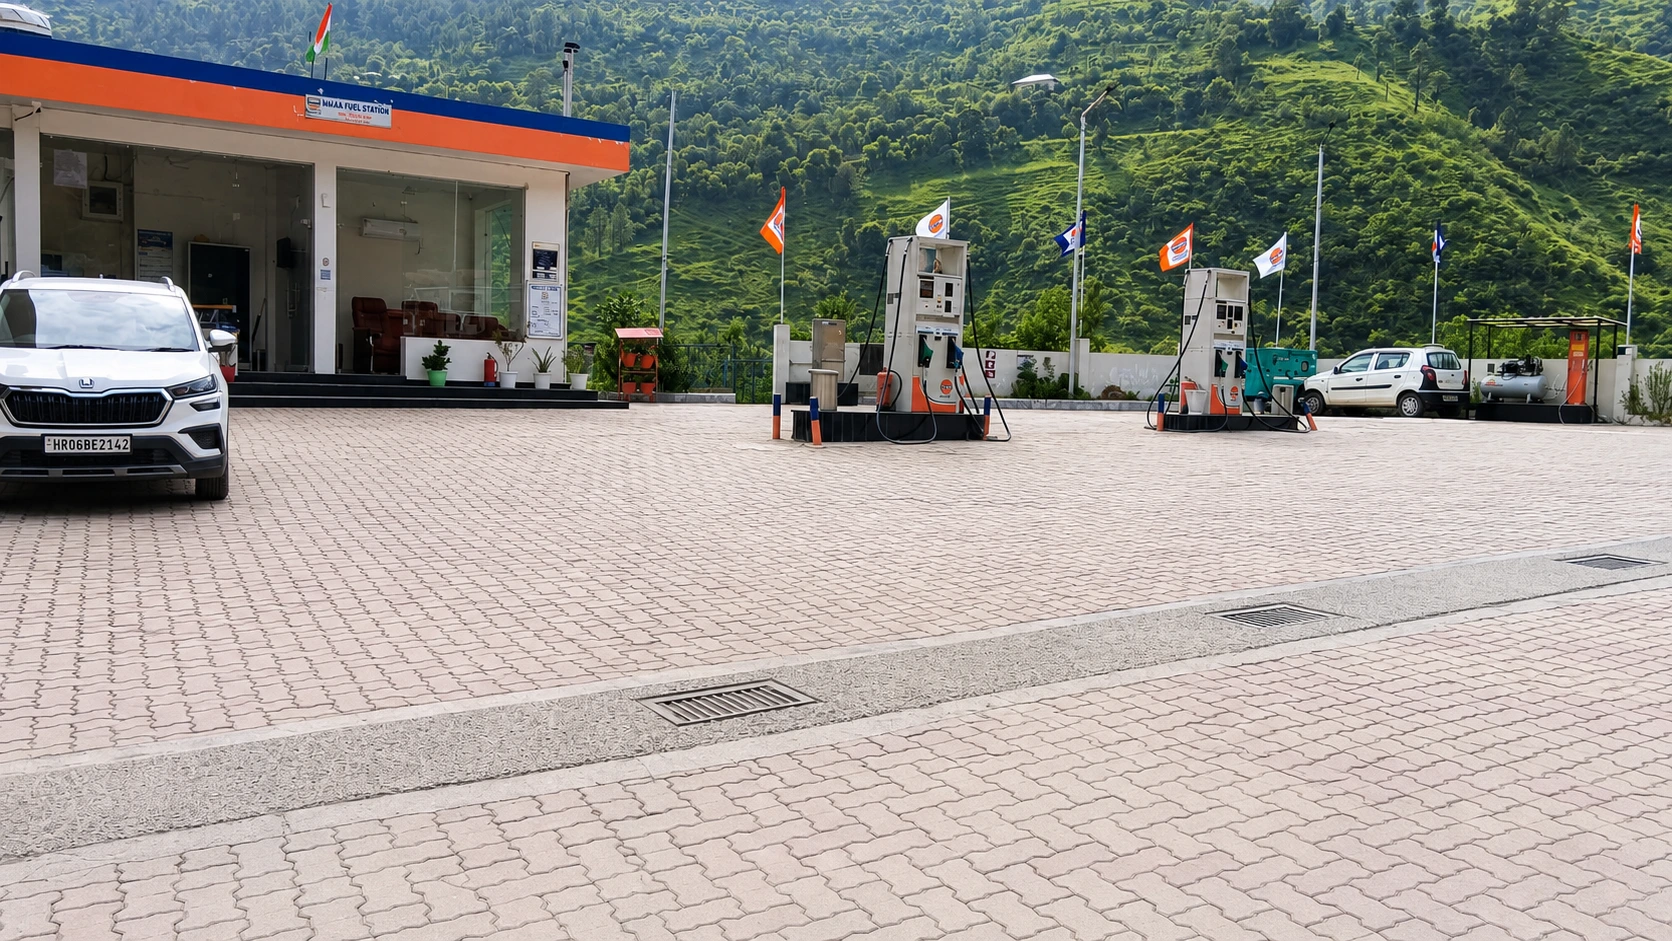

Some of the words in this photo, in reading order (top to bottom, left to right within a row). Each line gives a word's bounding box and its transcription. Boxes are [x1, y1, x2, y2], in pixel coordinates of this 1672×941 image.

[345, 102, 361, 112] FUEL
[362, 103, 390, 116] STATION
[53, 438, 129, 451] HR06BE2142
